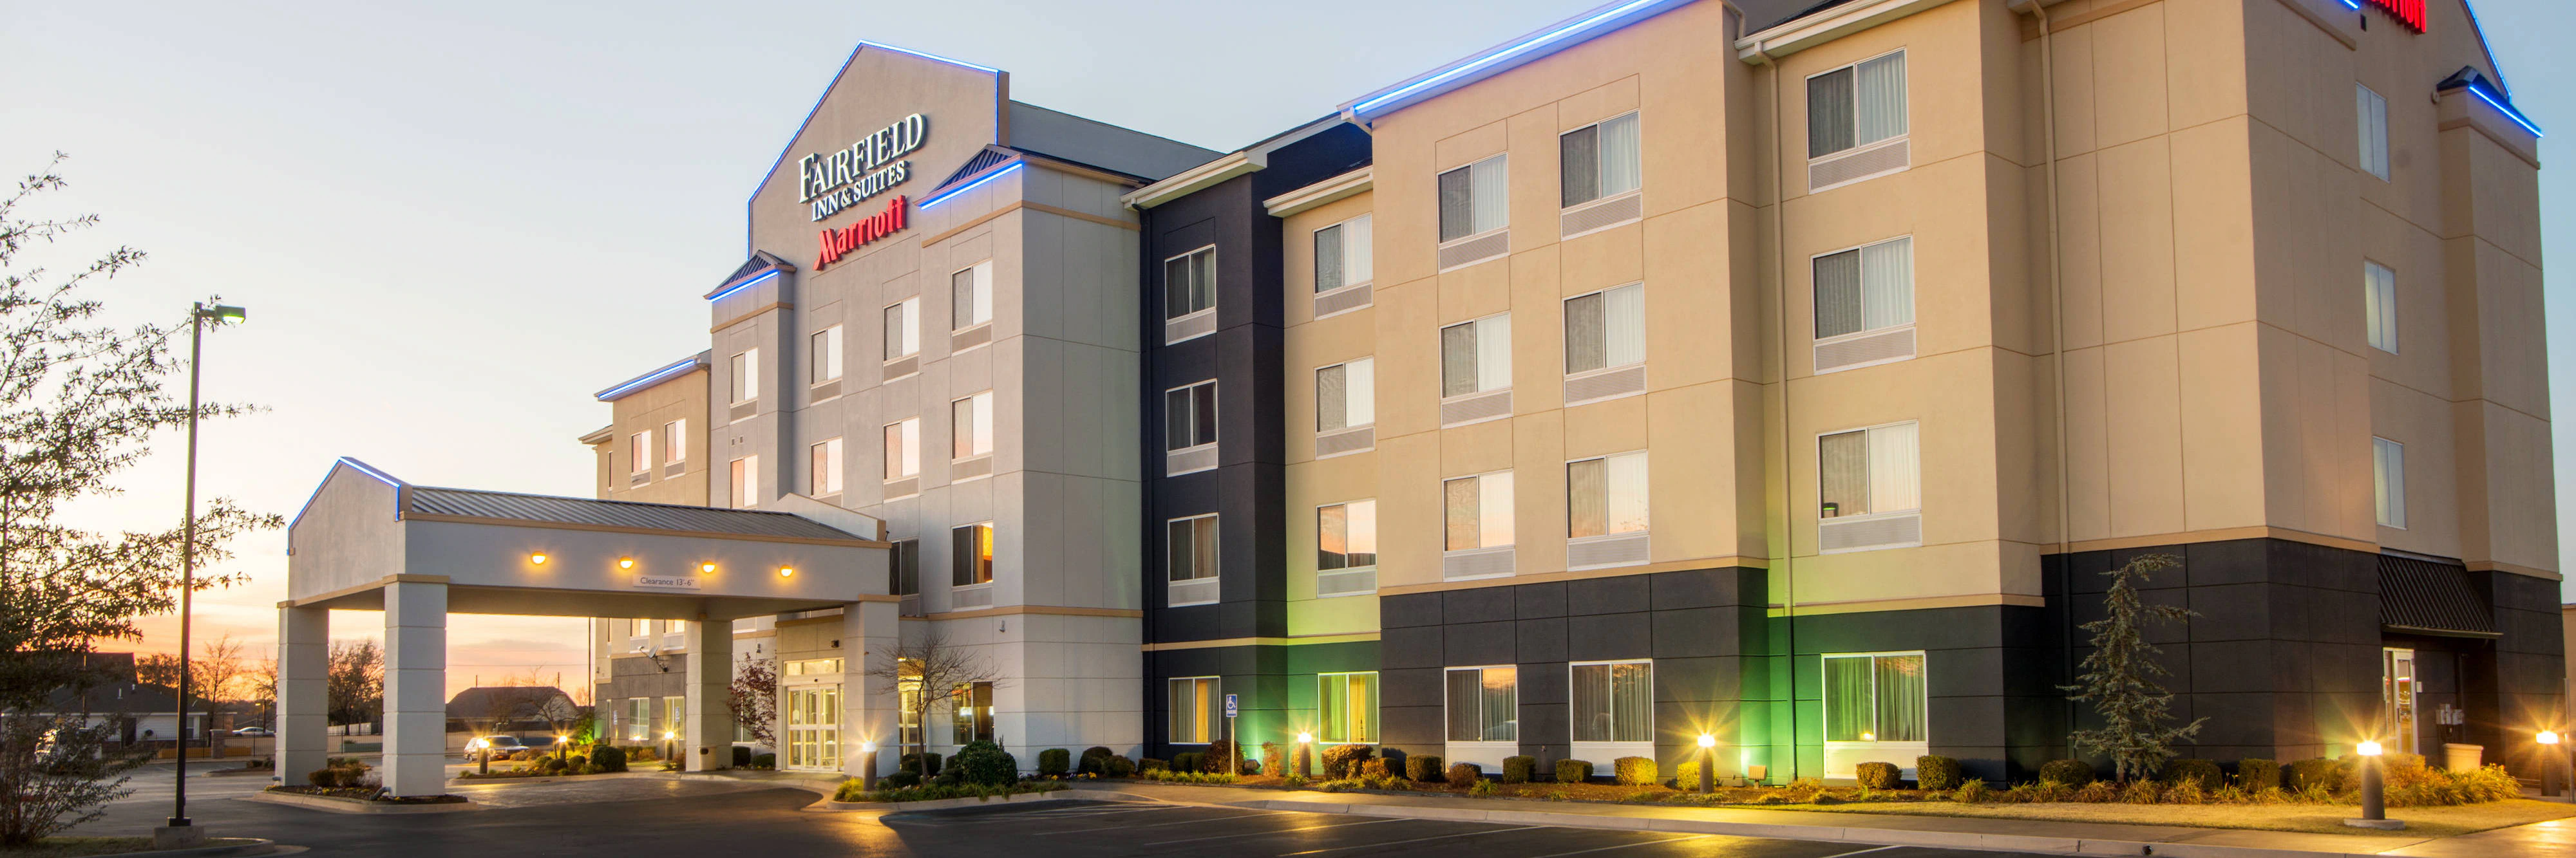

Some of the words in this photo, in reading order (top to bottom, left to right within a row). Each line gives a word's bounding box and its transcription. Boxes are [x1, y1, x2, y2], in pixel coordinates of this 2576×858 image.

[799, 113, 925, 203] FAIRFIELD
[811, 191, 840, 221] INN
[853, 160, 907, 203] SUITES
[813, 194, 907, 270] Marriott
[640, 577, 674, 586] Clearance
